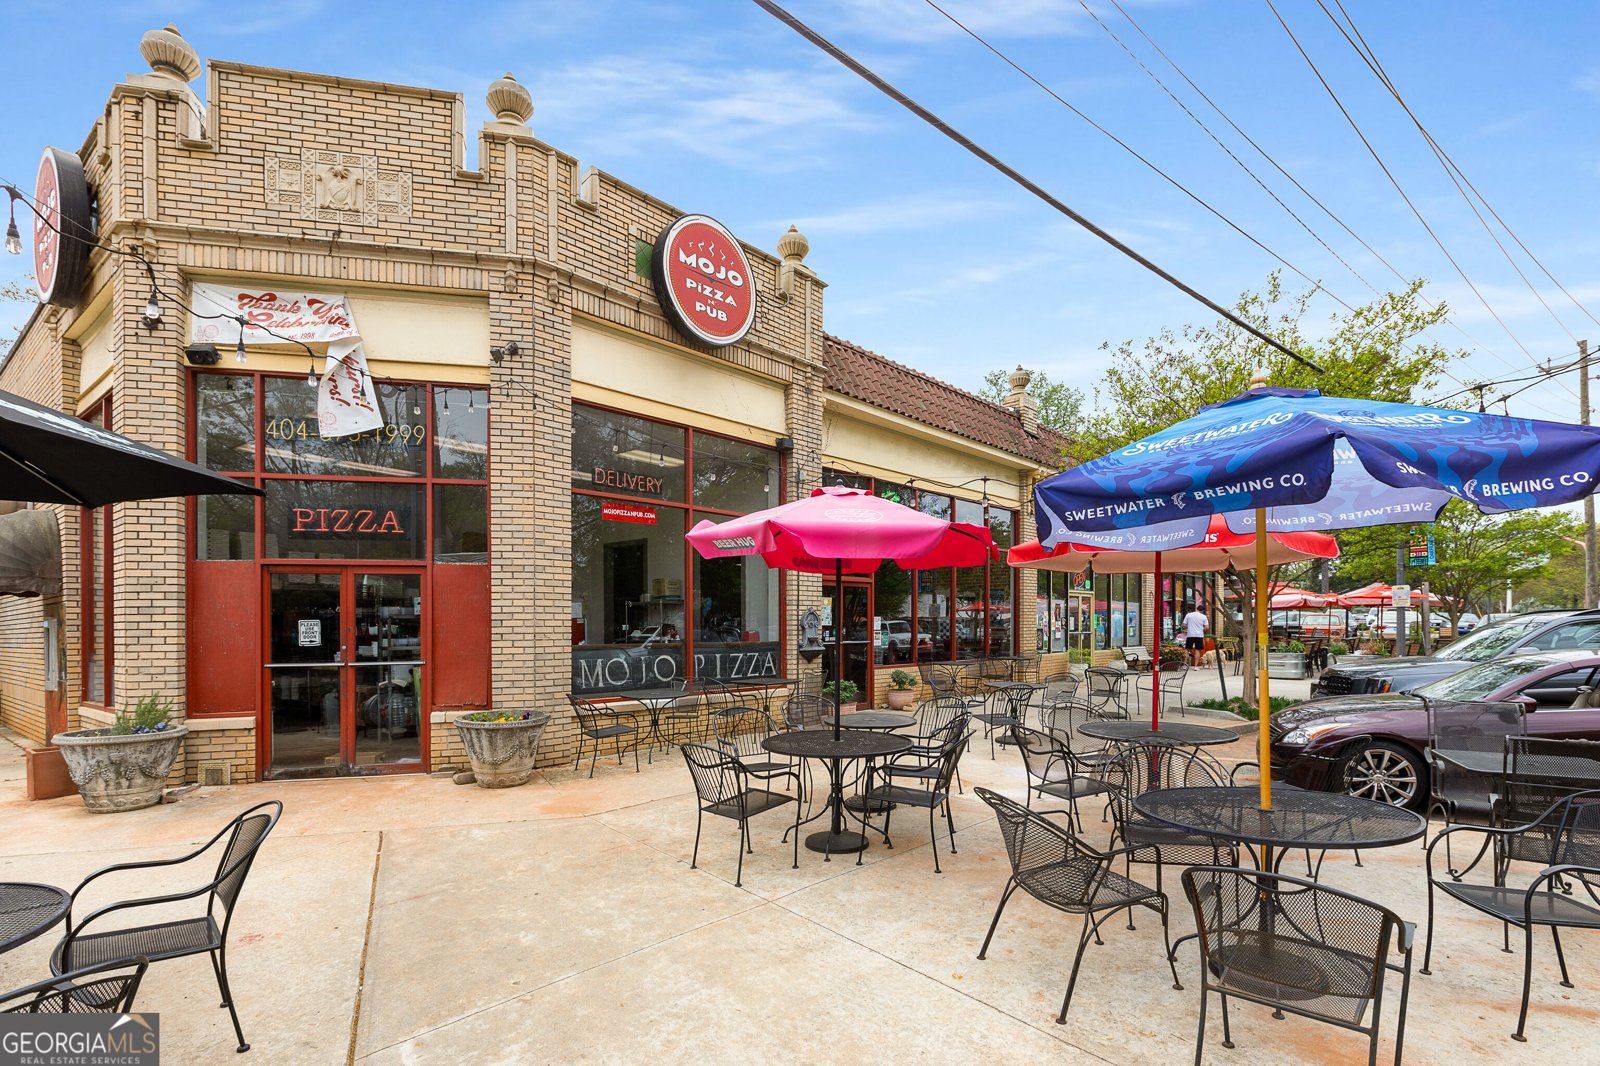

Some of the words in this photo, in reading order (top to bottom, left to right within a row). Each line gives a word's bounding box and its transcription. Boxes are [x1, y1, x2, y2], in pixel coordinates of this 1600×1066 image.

[679, 247, 744, 287] MOJO
[238, 292, 301, 314] Thank
[695, 301, 728, 322] PUB
[266, 418, 425, 446] 404--1999
[1121, 412, 1294, 456] SWEETWATER
[594, 467, 663, 493] DELIVERY
[1482, 477, 1555, 498] BREWING
[1559, 471, 1593, 486] CO.
[1065, 497, 1166, 522] SWEETWATER
[1194, 477, 1275, 501] BREWING
[1280, 472, 1307, 487] CO.
[292, 508, 405, 533] PIZZA
[603, 508, 656, 519] MOJOPIZZANPUB.COM
[712, 538, 736, 549] BEER
[735, 535, 755, 549] HUG
[579, 654, 677, 689] MOJO
[694, 651, 777, 679] PIZZA
